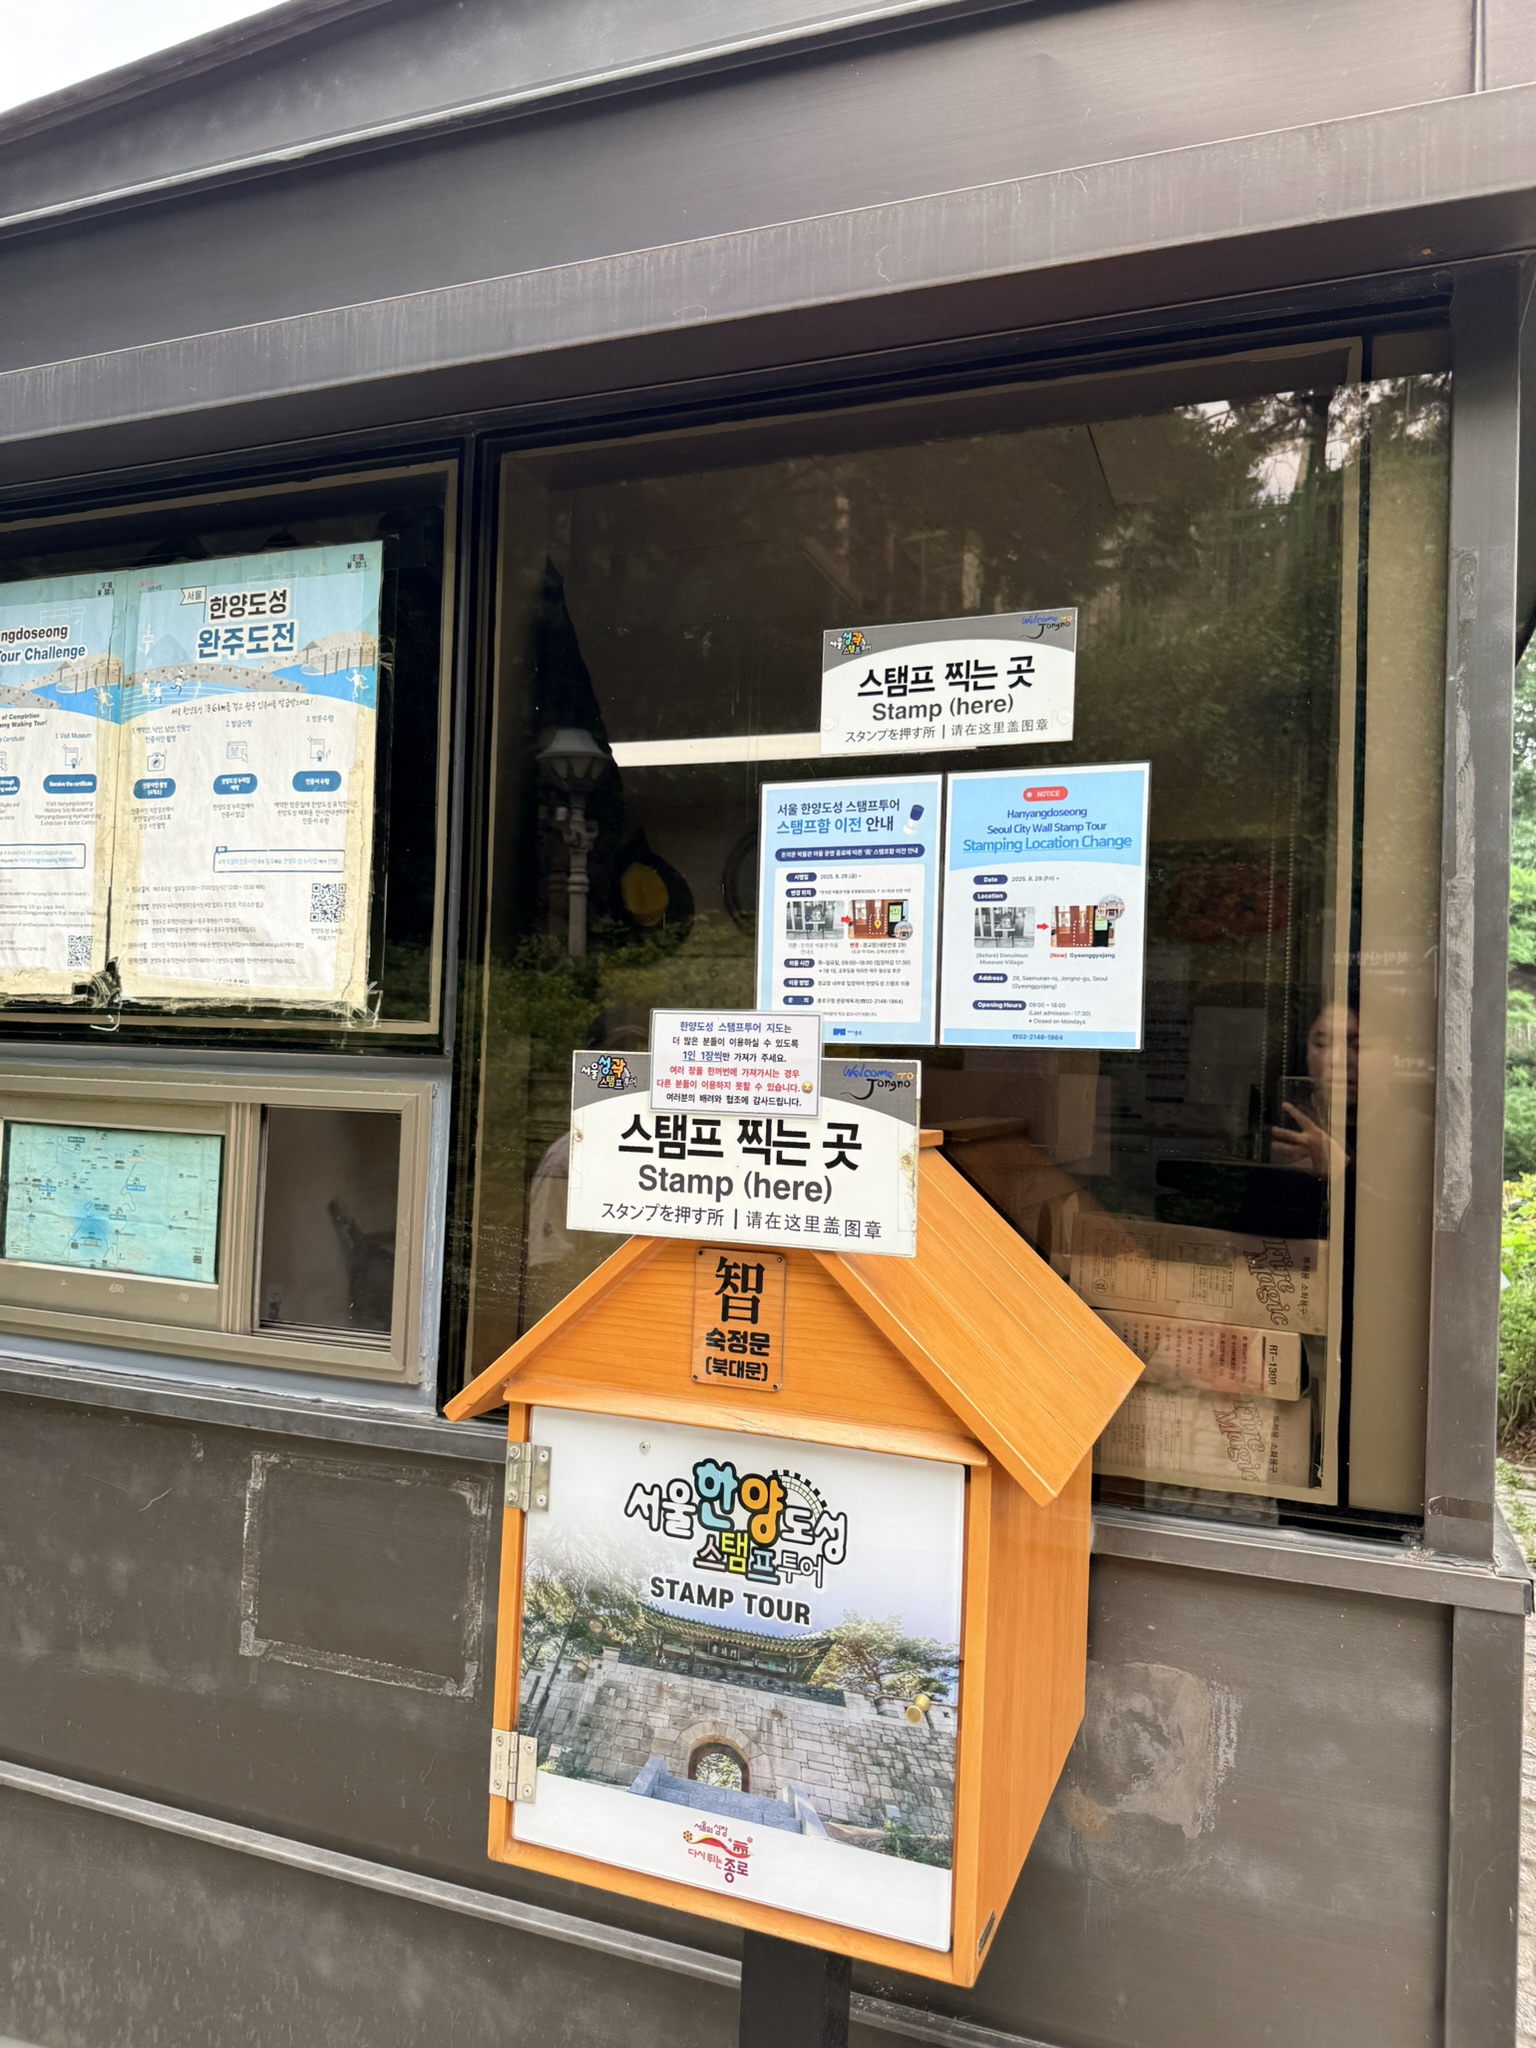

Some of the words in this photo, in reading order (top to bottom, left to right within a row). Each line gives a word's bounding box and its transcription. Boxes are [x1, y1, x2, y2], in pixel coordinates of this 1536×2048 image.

[186, 590, 203, 602] 서울
[208, 588, 288, 621] 한양도성
[197, 621, 296, 659] 완주도전
[1019, 621, 1071, 639] Jongno
[24, 645, 86, 661] Challenge
[857, 664, 936, 699] 스탬프
[944, 659, 999, 693] 찍는
[1006, 655, 1036, 690] 곳
[872, 702, 943, 722] Stamp
[949, 693, 1014, 717] (here)
[845, 725, 936, 743] スタンプを押す所
[951, 718, 1049, 737] 请在这里盖图章
[1036, 790, 1061, 798] NOTICE
[777, 803, 799, 816] 서울
[800, 801, 844, 815] 한양도성
[845, 798, 900, 814] 스탬프투어
[1007, 808, 1088, 820] Hanyangdoseong
[776, 818, 831, 835] 스탬프함
[834, 816, 862, 833] 이전
[866, 815, 894, 832] 안내
[987, 824, 1013, 835] Seoul
[1013, 823, 1031, 836] City
[1032, 823, 1053, 833] Wall
[1054, 822, 1084, 834] Stamp
[1085, 821, 1108, 831] Tour
[963, 838, 1023, 854] Stamping
[1026, 835, 1079, 850] Location
[1081, 834, 1133, 850] Change
[680, 1021, 714, 1032] 한양도성
[718, 1022, 761, 1033] 스탬프투어
[766, 1022, 792, 1034] 지도는
[672, 1036, 680, 1045] 더
[683, 1036, 699, 1046] 많은
[702, 1037, 725, 1047] 분들이
[729, 1038, 759, 1048] 이용하실
[763, 1038, 771, 1048] 수
[775, 1038, 799, 1048] 있도록
[683, 1050, 696, 1061] 1인
[701, 1051, 730, 1061] 1장씩만
[734, 1052, 757, 1062] 가져가
[761, 1053, 787, 1063] 주세요.
[669, 1066, 685, 1076] 여러
[688, 1066, 703, 1076] 장을
[707, 1067, 737, 1077] 한꺼번에
[741, 1068, 780, 1078] 가져가시는
[784, 1069, 800, 1079] 경우
[842, 1063, 894, 1080] Welcome
[656, 1079, 672, 1089] 다른
[675, 1079, 698, 1089] 분들이
[701, 1080, 731, 1090] 이용하지
[735, 1081, 750, 1091] 못할
[754, 1082, 763, 1091] 수
[767, 1082, 801, 1093] 있습니다.
[839, 1078, 912, 1101] Jongno
[666, 1092, 695, 1103] 여러분의
[699, 1093, 722, 1104] 배려와
[726, 1094, 749, 1105] 협조에
[753, 1095, 802, 1106] 감사드립니다.
[618, 1114, 724, 1160] 스탬프
[736, 1118, 811, 1167] 찍는
[822, 1122, 862, 1171] 곳
[638, 1164, 734, 1203] Stamp
[743, 1170, 833, 1205] (here)
[601, 1203, 724, 1227] スタンプを押す所
[746, 1210, 882, 1240] 请在这里盖图章
[1262, 1240, 1296, 1294] Fire
[714, 1256, 766, 1325] 智
[1243, 1250, 1290, 1327] Magic
[705, 1327, 771, 1357] 숙정문
[1267, 1344, 1279, 1386] RT-1300
[1231, 1398, 1266, 1453] Fire
[1213, 1410, 1261, 1483] Magic
[624, 1478, 698, 1540] 서울
[693, 1529, 824, 1590] 스탬프투어
[650, 1575, 735, 1610] STAMP
[742, 1591, 811, 1626] TOUR
[694, 1820, 714, 1834] 서울의
[714, 1824, 729, 1838] 심장
[687, 1848, 706, 1860] 다시
[707, 1853, 723, 1870] 뛰는
[723, 1857, 750, 1884] 종로
